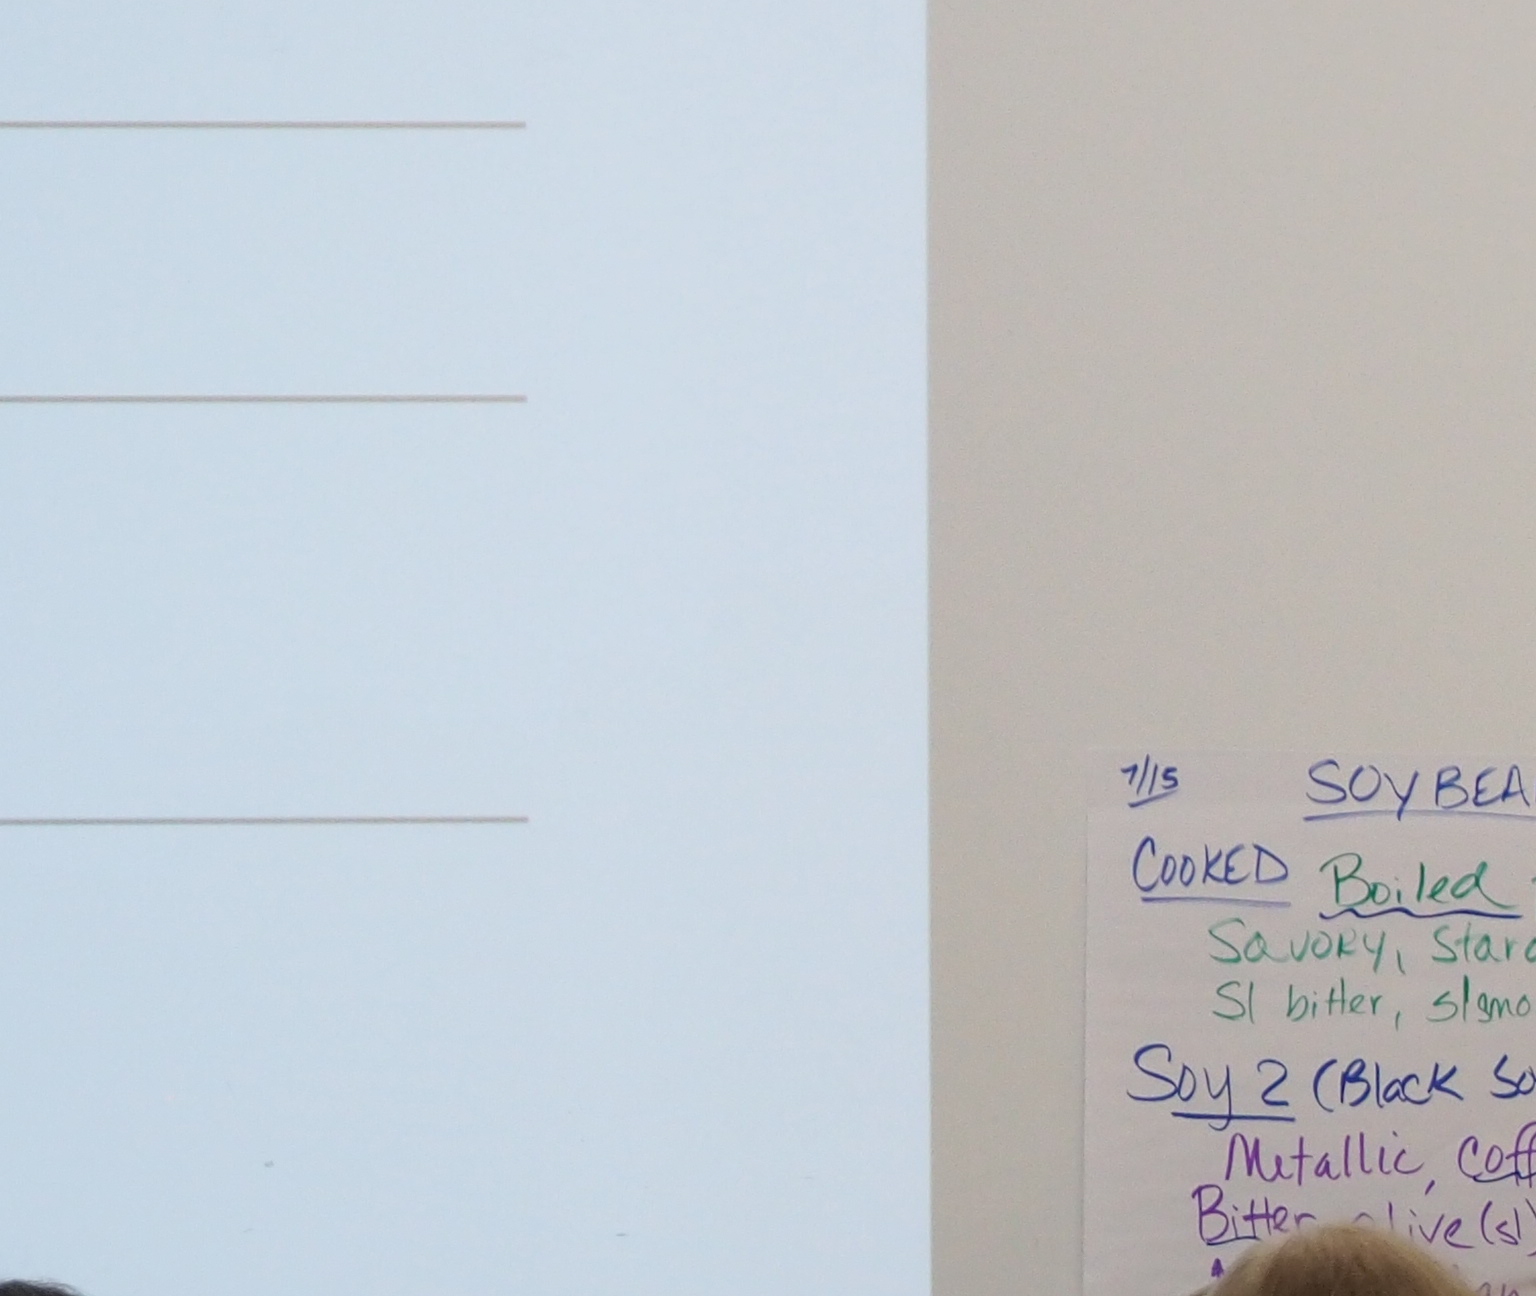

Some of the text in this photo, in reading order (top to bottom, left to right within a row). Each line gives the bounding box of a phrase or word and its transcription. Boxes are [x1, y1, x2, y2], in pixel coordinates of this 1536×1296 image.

[1132, 836, 1289, 892] COOKED
[1319, 852, 1516, 910] Boiled
[1127, 1043, 1237, 1130] Soy
[1256, 1058, 1291, 1109] 2
[1312, 1058, 1464, 1113] (Black
